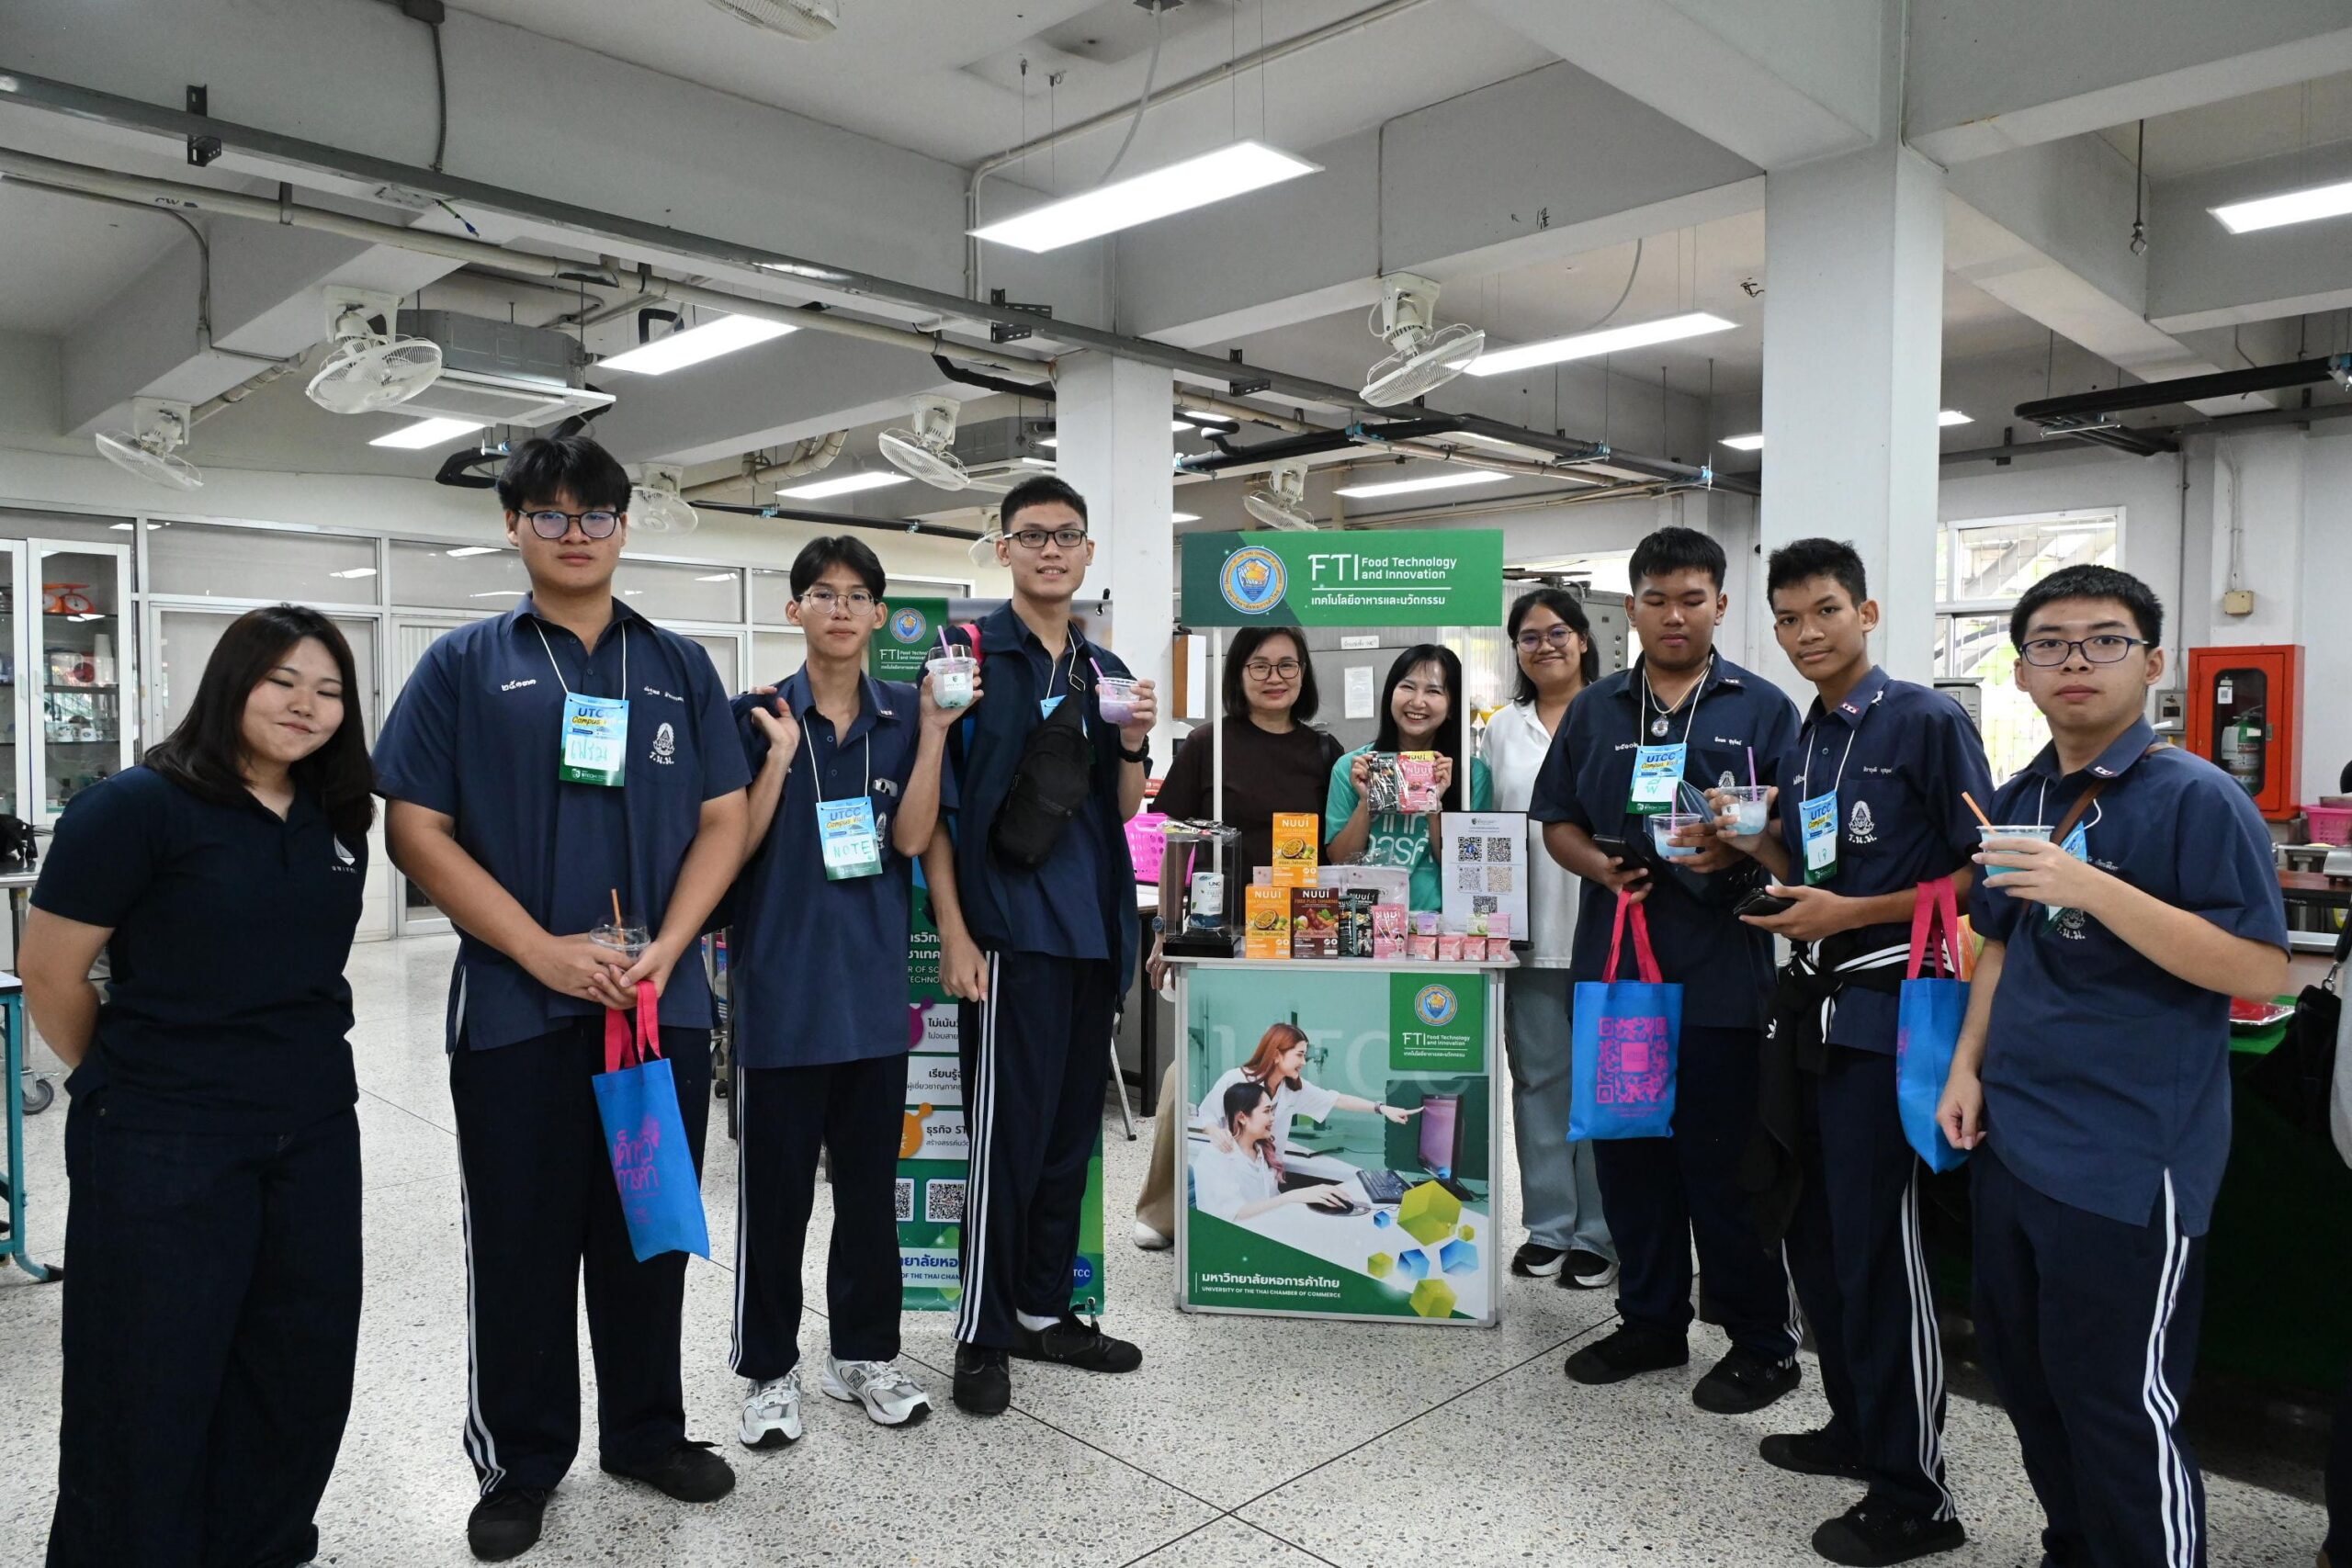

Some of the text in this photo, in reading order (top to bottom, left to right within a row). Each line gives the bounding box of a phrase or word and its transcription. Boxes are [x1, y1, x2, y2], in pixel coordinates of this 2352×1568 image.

[1307, 554, 1359, 581] FTI
[1362, 557, 1457, 570] Food Technology
[1362, 569, 1446, 580] and Innovation
[1311, 593, 1445, 605] เทคโนโลยีอาหารและนวัตกรรม
[879, 649, 899, 660] FTI
[1646, 752, 1676, 762] UTCC
[830, 807, 861, 821] UTCC
[1811, 803, 1832, 820] UTCC
[833, 840, 870, 859] NOTE
[1402, 1032, 1425, 1045] FTI
[926, 1125, 952, 1136] ธุรกิจ
[1202, 1272, 1340, 1288] มหาวิทยาลัยหอการค้าไทย
